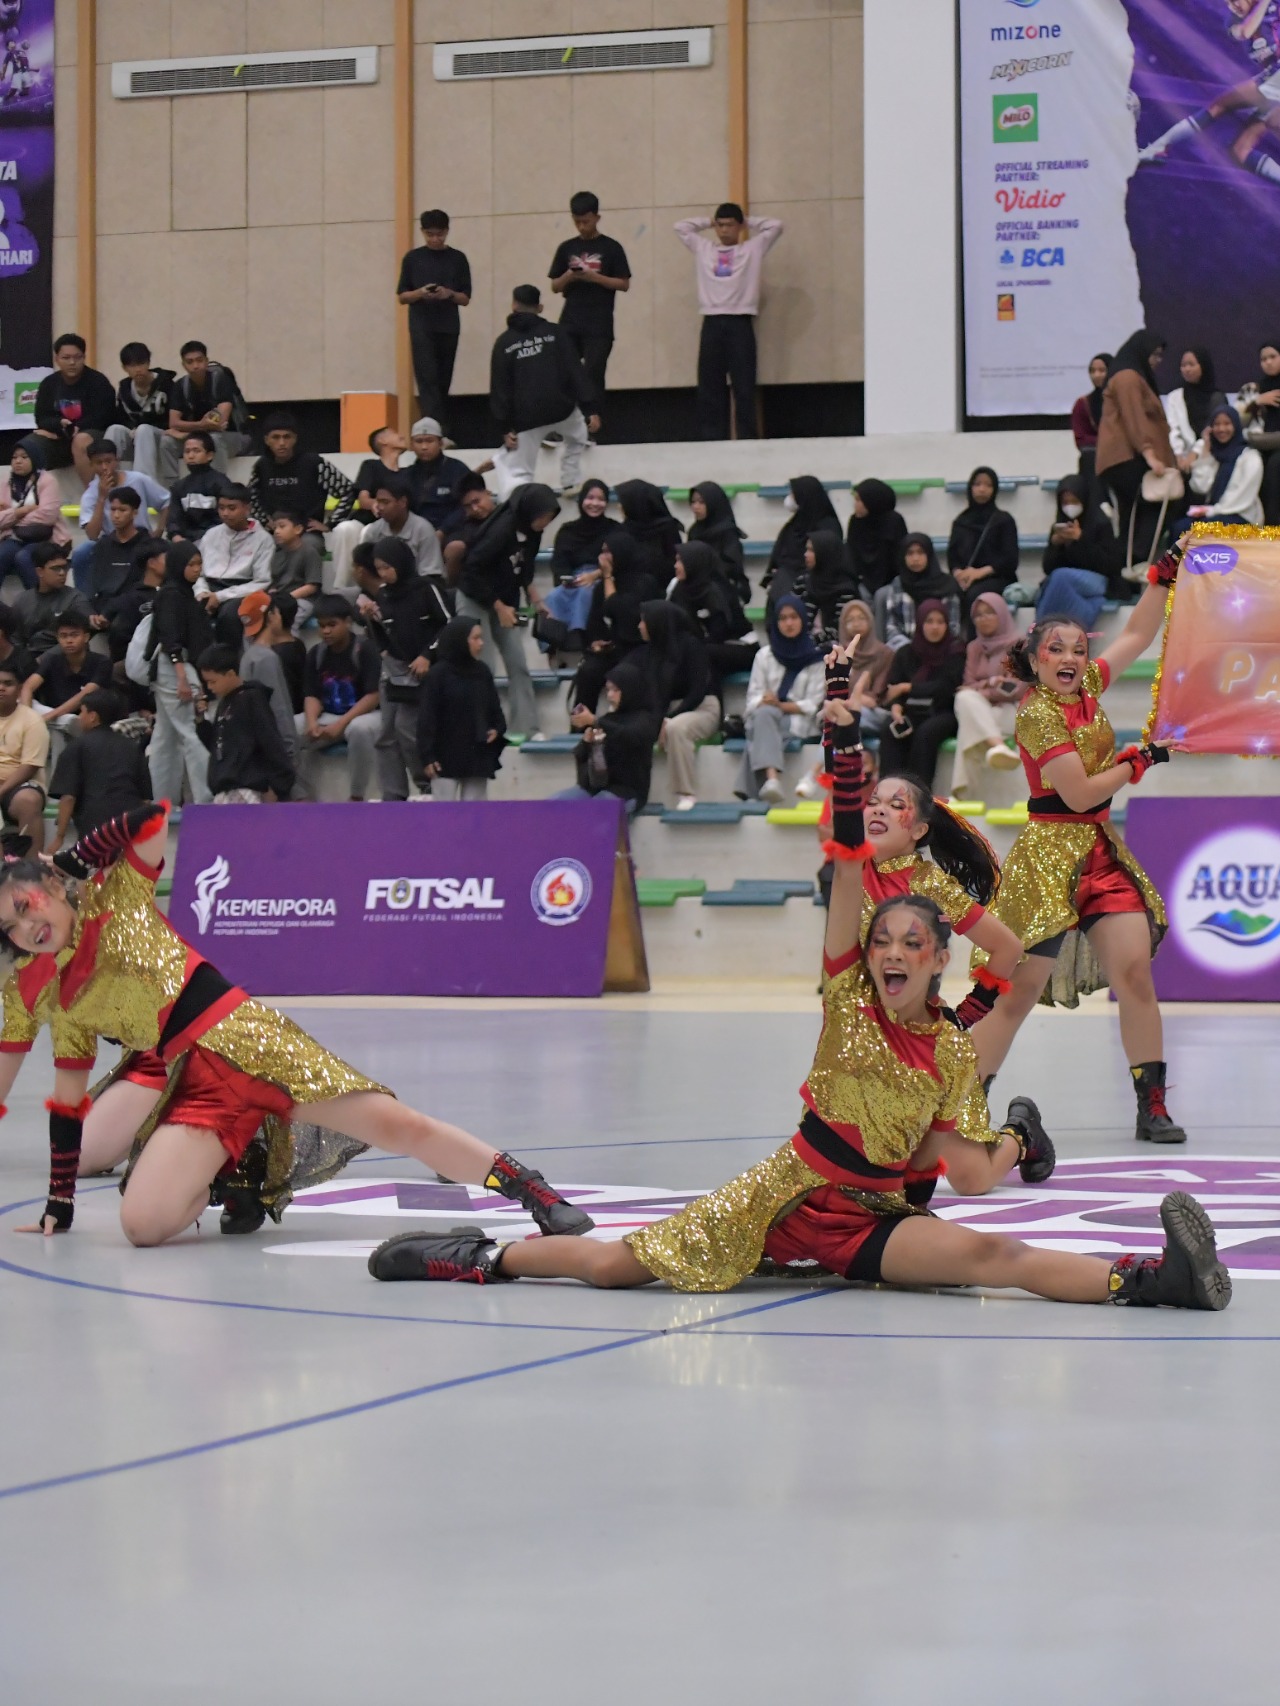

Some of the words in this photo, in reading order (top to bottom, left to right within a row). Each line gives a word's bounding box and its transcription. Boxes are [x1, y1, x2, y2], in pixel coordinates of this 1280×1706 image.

[991, 24, 1061, 41] mizone
[1003, 111, 1031, 124] MILO
[995, 162, 1032, 172] OFFICIAL
[1036, 160, 1089, 170] STREAMING
[995, 187, 1066, 213] Vidio
[996, 221, 1033, 231] OFFICIAL
[1037, 219, 1079, 229] BANKING
[1021, 247, 1065, 267] BCA
[1192, 552, 1231, 565] AXIS
[365, 877, 505, 910] FUTSAL
[215, 898, 336, 917] KEMENPORA
[363, 914, 409, 922] FEDERASI
[451, 913, 503, 921] INDONESIA
